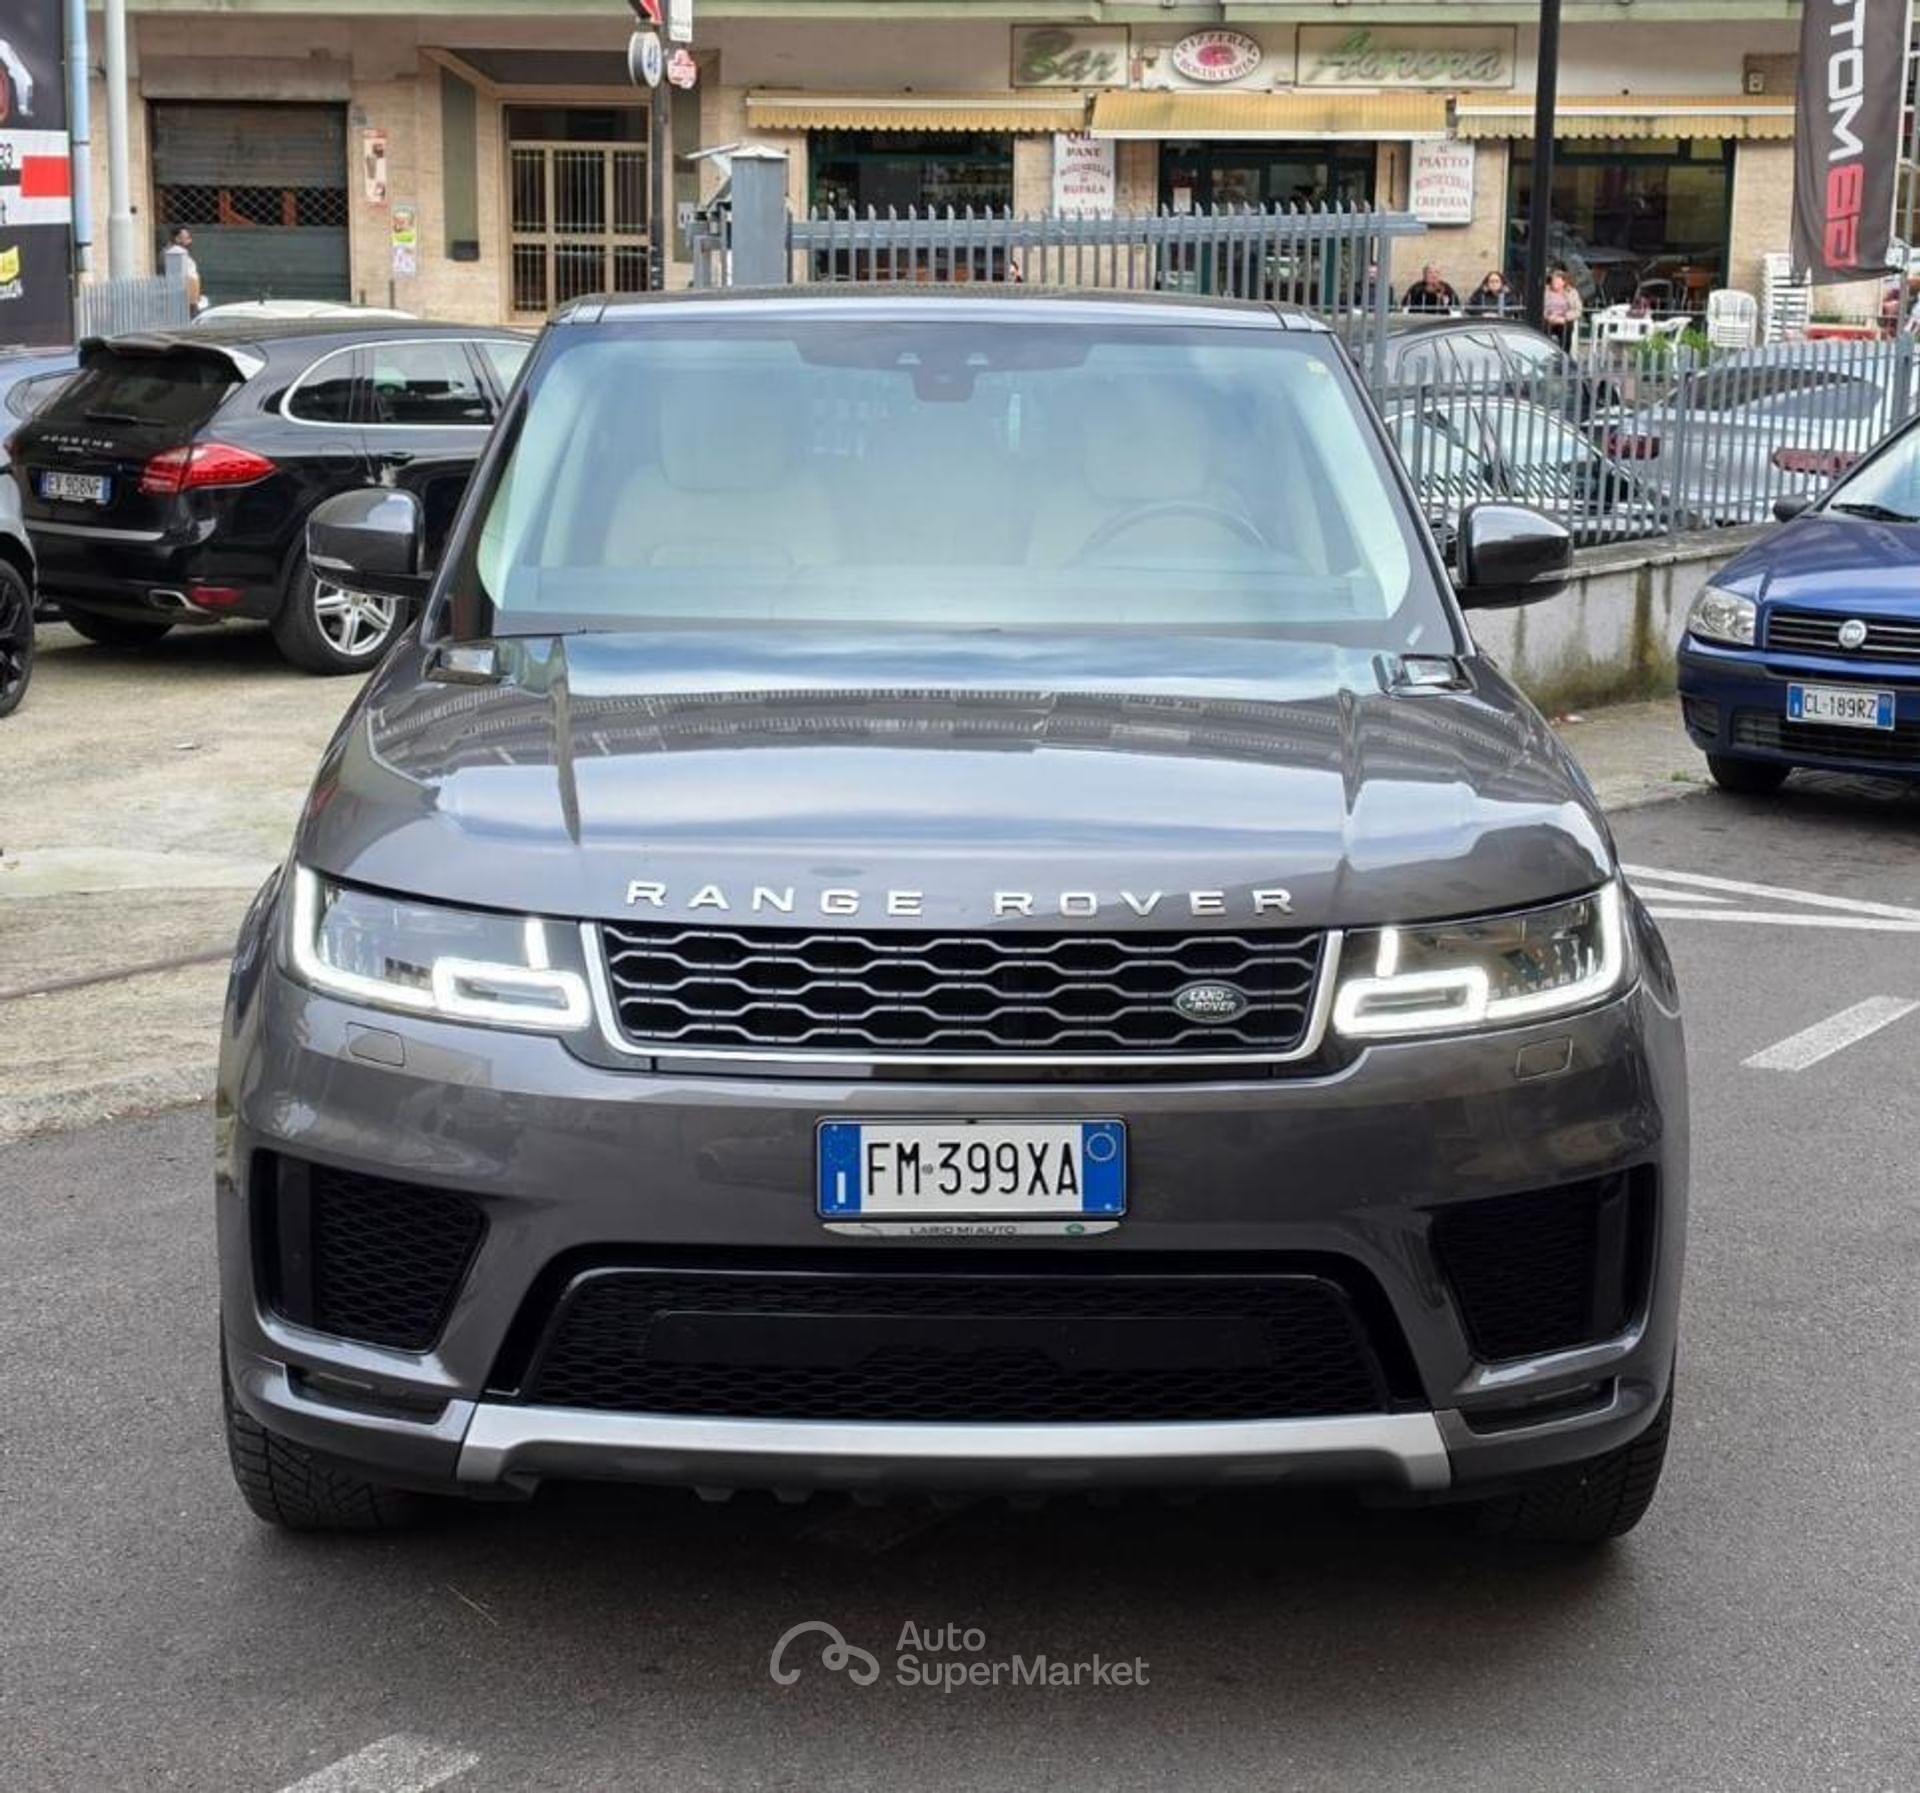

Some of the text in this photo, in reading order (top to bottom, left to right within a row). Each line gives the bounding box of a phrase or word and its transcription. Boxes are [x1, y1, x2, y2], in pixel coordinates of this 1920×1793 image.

[1019, 30, 1117, 82] Bar
[626, 880, 1294, 918] RANGE ROVER
[976, 1225, 1017, 1235] AUTO
